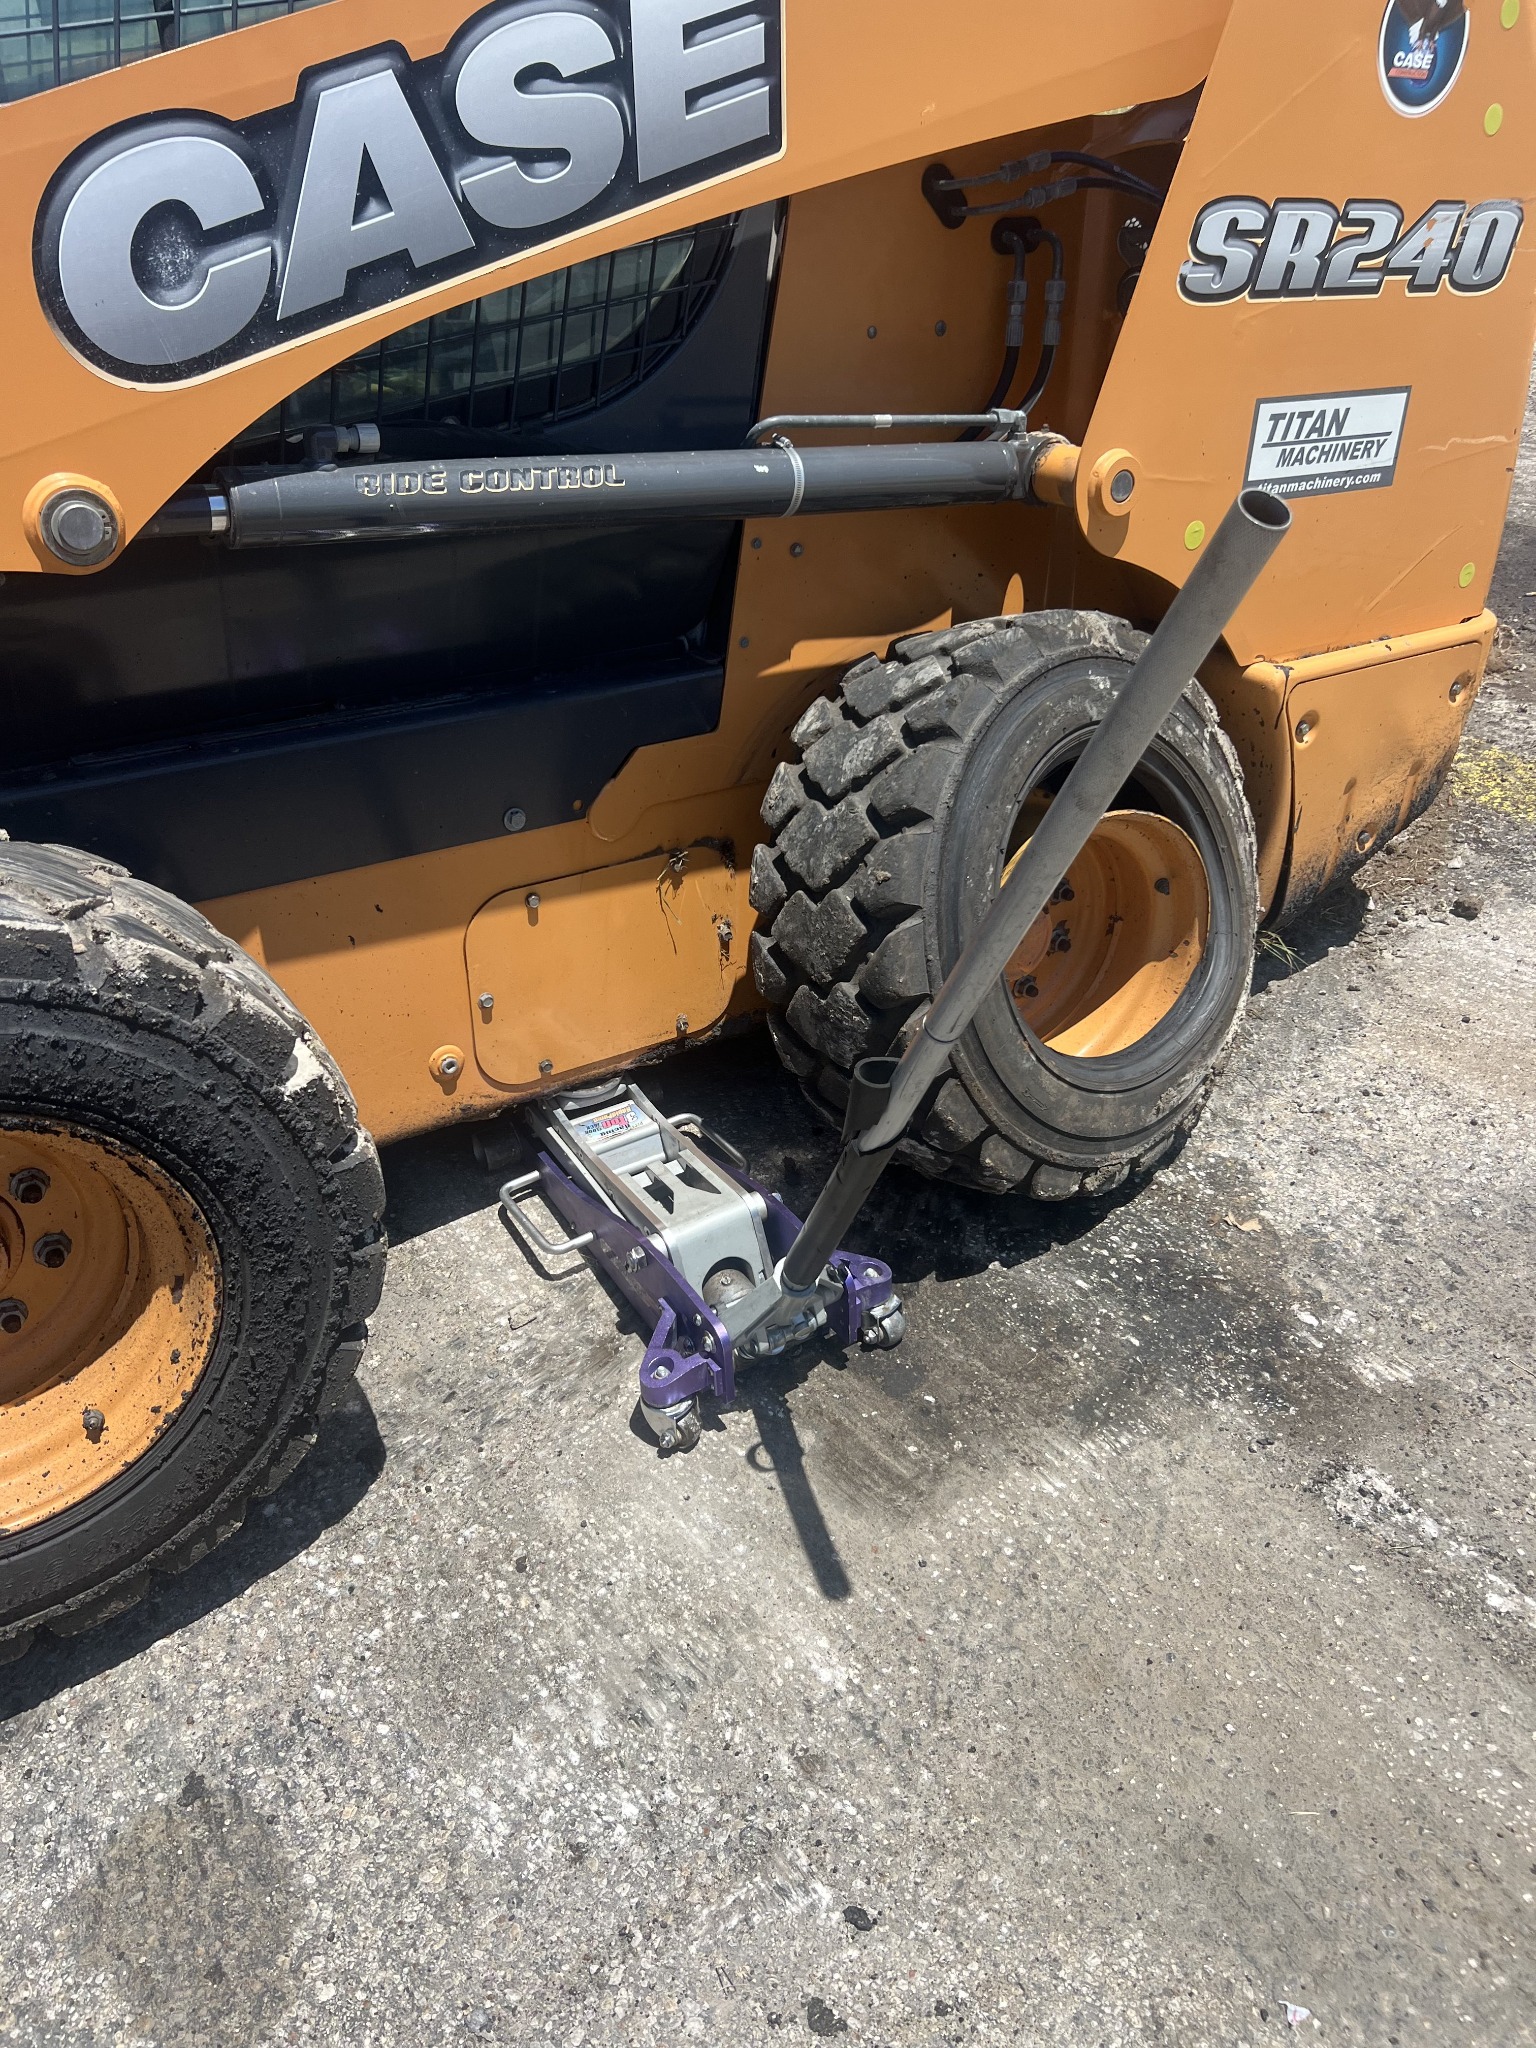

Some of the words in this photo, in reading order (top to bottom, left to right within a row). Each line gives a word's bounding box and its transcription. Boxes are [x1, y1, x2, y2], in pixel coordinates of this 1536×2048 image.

[1393, 50, 1435, 69] CASE
[58, 0, 770, 366] CASE
[1180, 197, 1522, 297] SR240
[1266, 407, 1351, 442] TITAN
[1275, 438, 1389, 468] MACHINERY
[354, 470, 447, 496] RIDE
[459, 464, 626, 493] CONTROL
